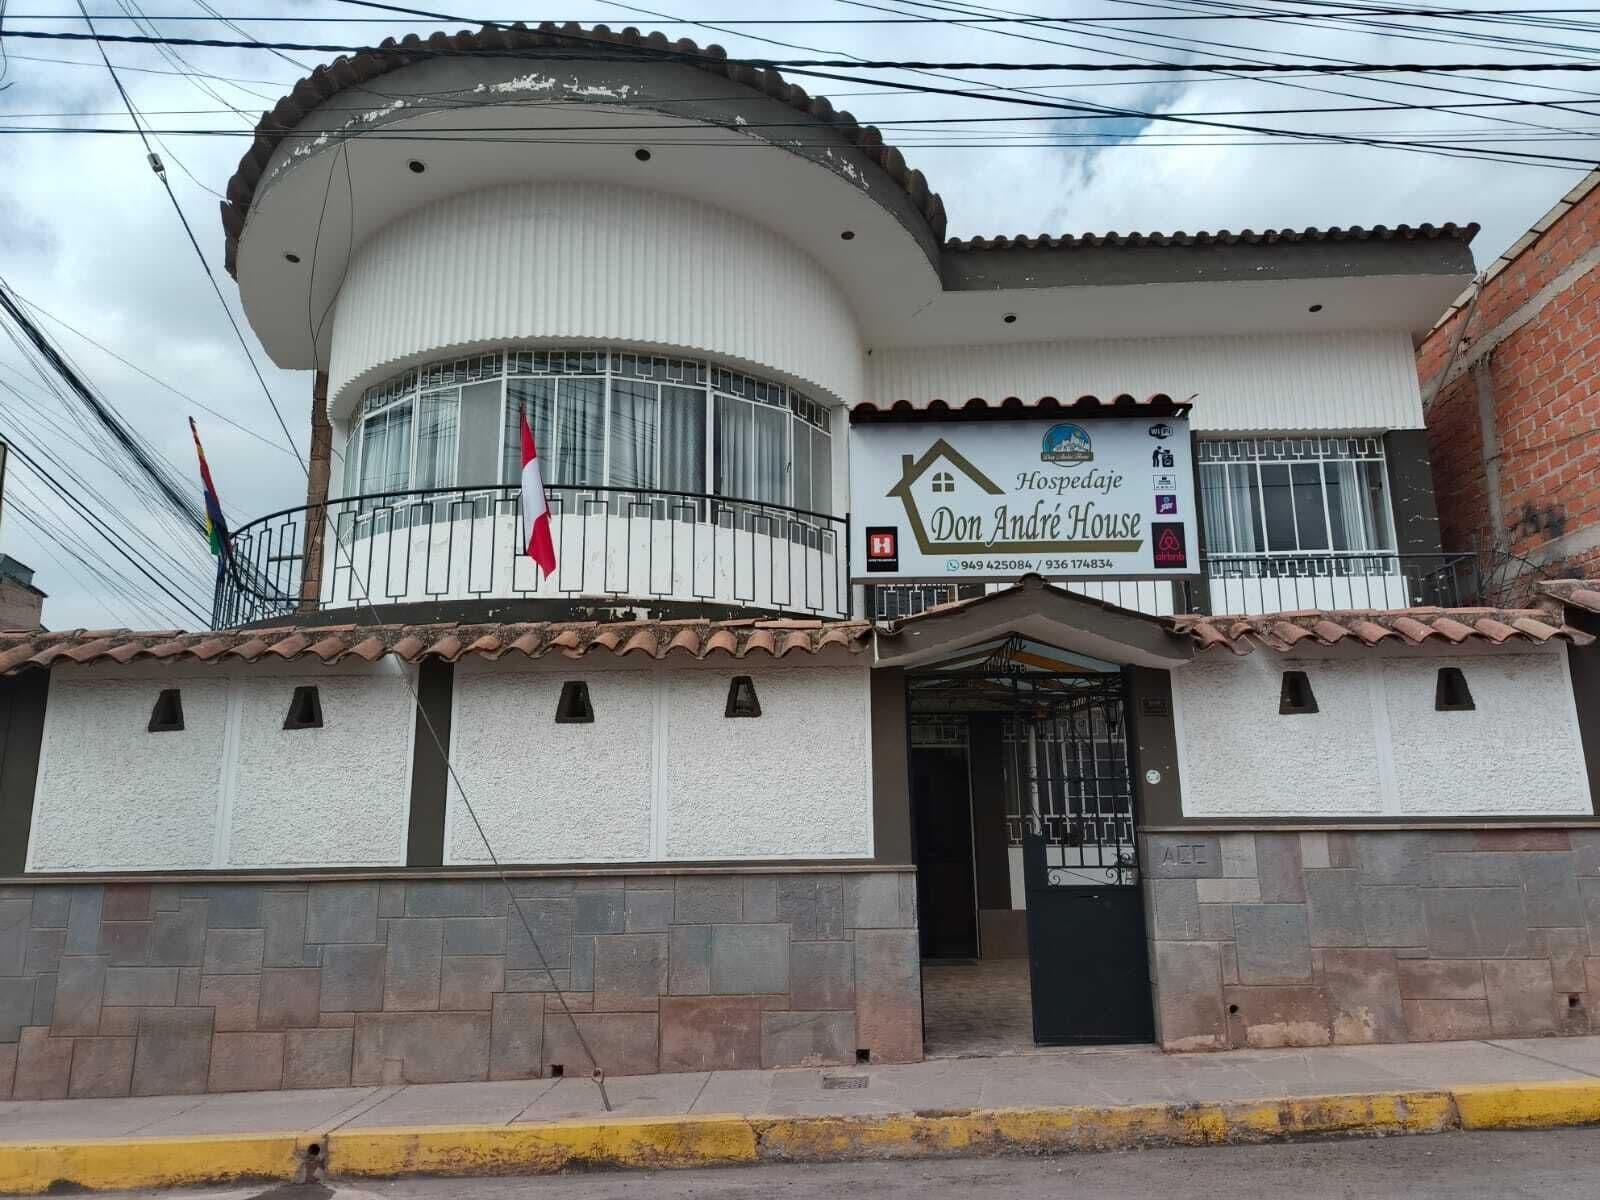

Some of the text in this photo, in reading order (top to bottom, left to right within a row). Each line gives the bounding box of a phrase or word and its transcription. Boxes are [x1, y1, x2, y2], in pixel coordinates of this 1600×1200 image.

[1015, 468, 1123, 495] Hospedaje
[931, 499, 1142, 547] Don André House
[961, 560, 984, 571] 949
[986, 560, 1033, 571] 425084
[1045, 559, 1069, 570] 936
[1071, 559, 1113, 570] 174834
[1155, 551, 1185, 562] airbnb
